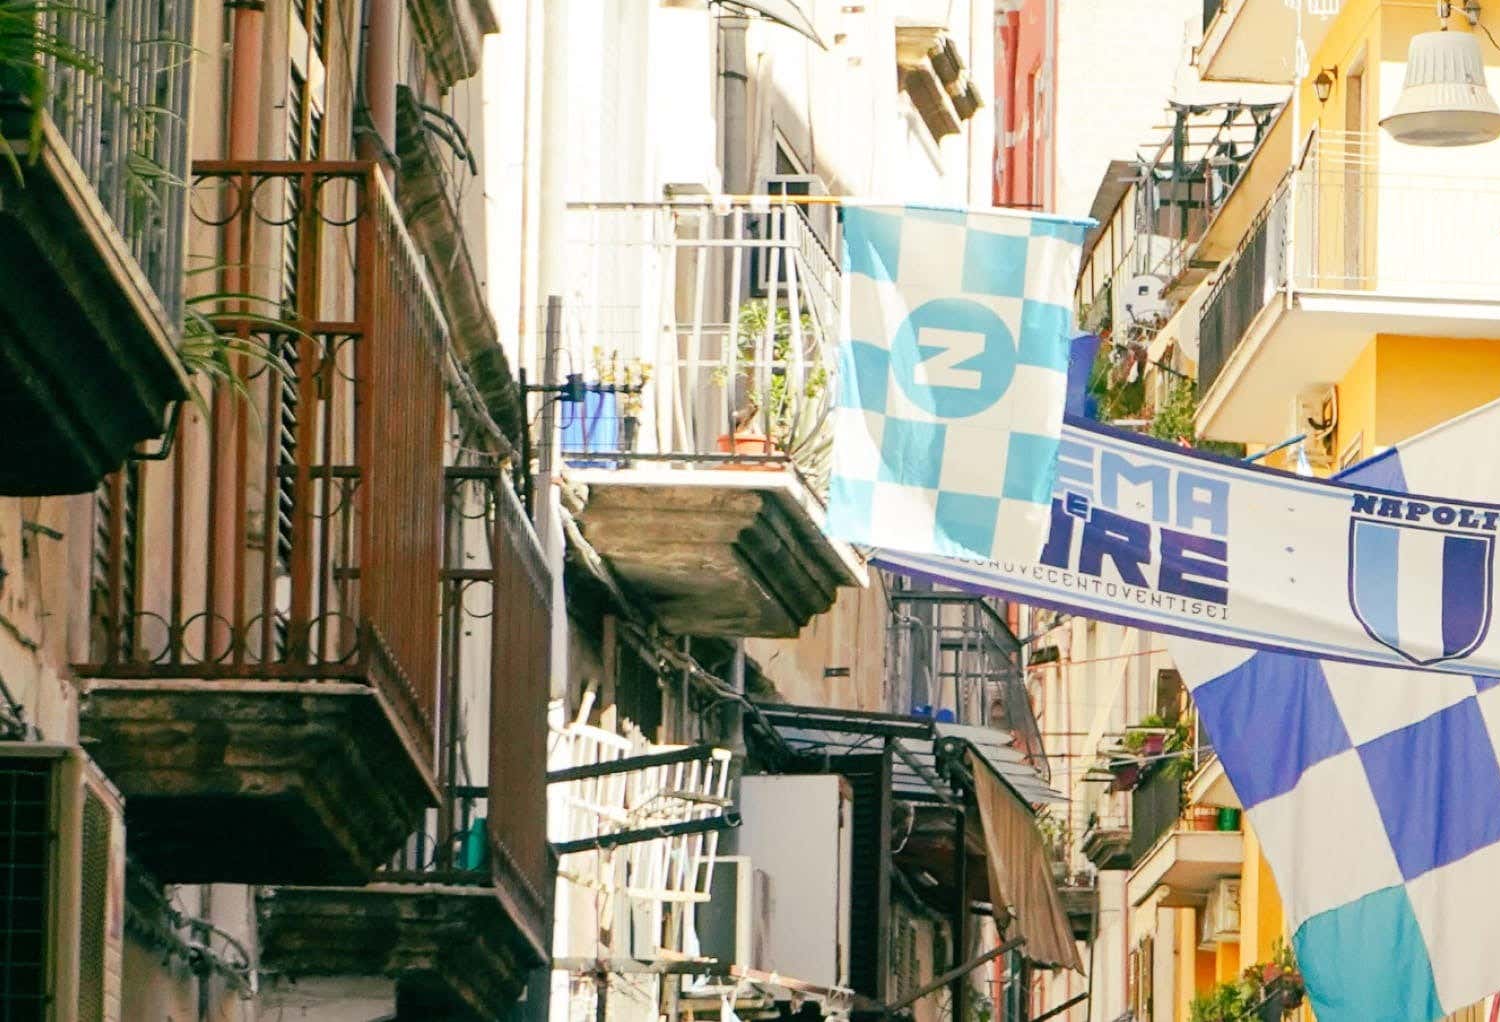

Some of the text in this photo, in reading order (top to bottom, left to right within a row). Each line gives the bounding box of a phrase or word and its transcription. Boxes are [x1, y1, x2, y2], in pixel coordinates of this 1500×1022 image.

[1067, 491, 1088, 519] E
[1351, 493, 1500, 531] NAPOLI
[946, 555, 1229, 620] NOVECENTOVENTISEI
